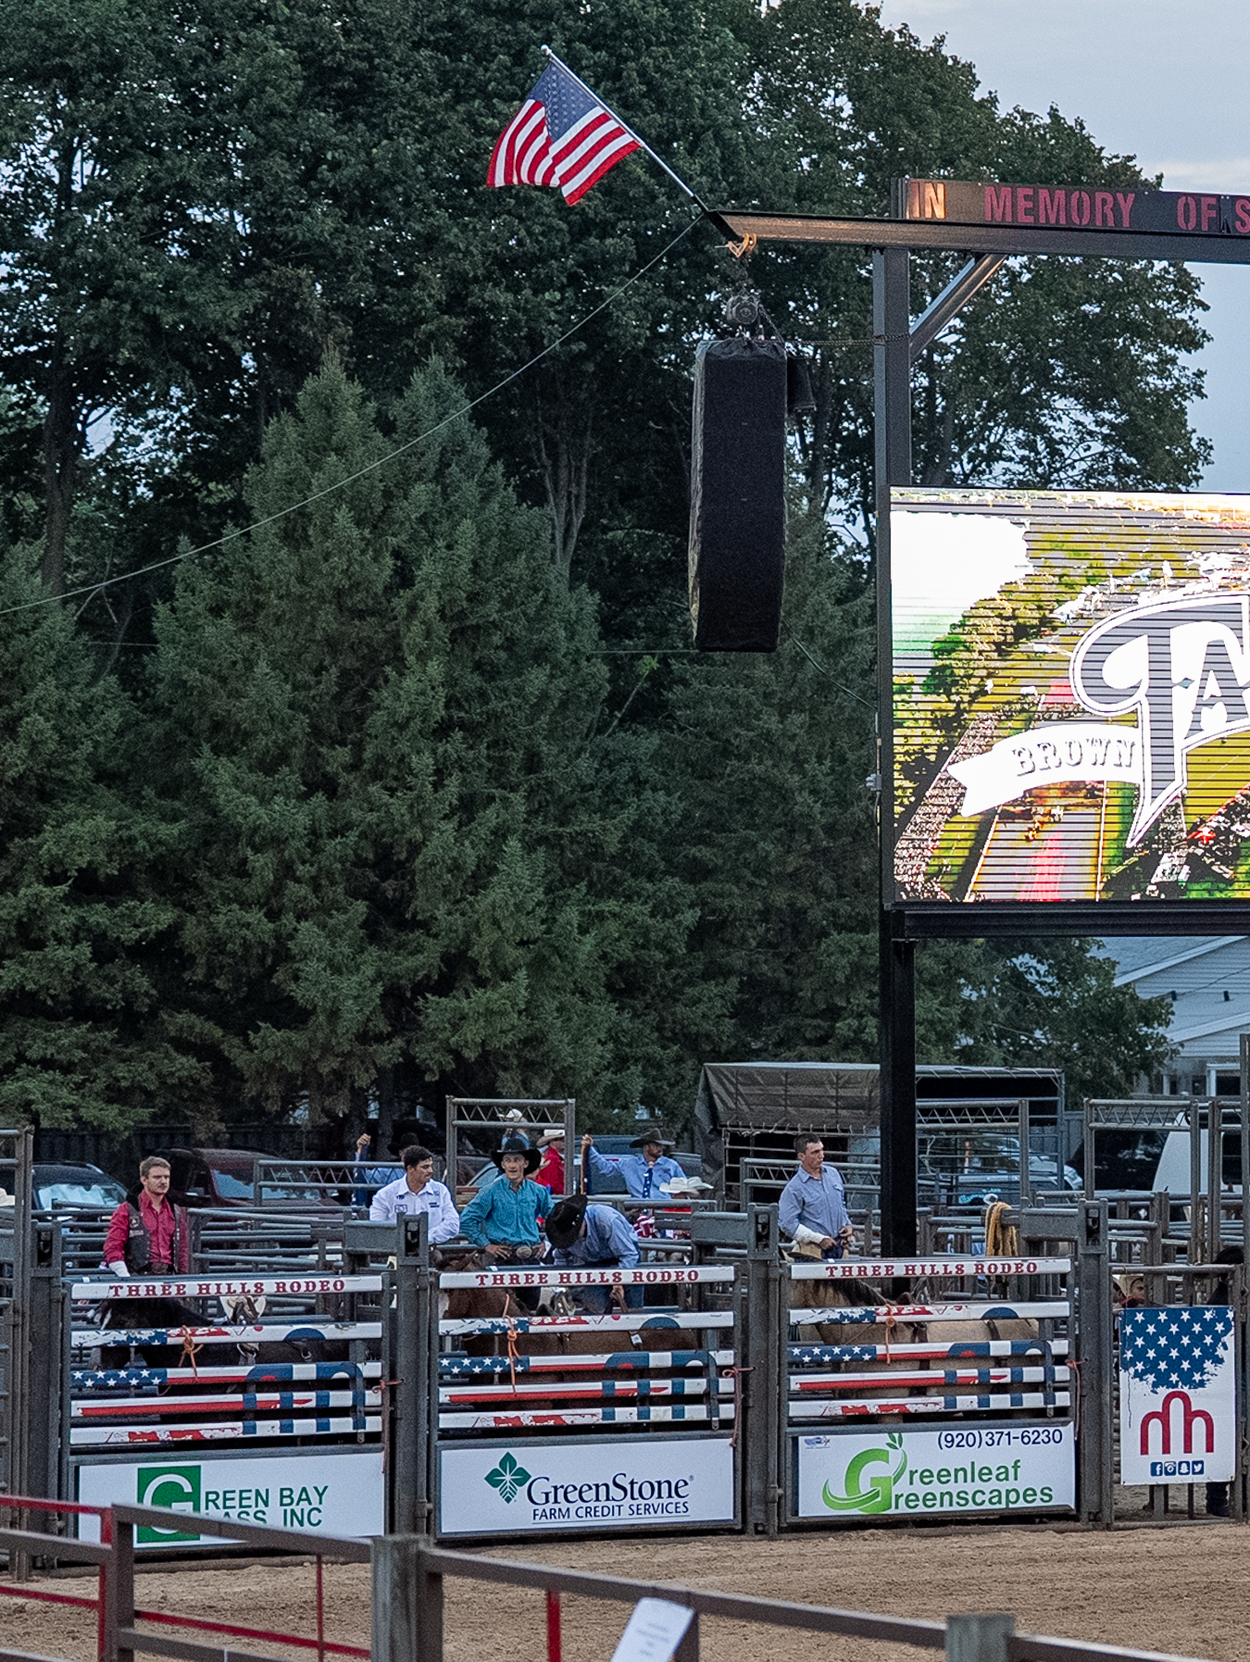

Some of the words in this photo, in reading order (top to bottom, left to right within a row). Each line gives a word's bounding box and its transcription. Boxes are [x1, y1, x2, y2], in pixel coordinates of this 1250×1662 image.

[911, 181, 946, 219] IN
[984, 185, 1137, 228] MEMORY
[1177, 194, 1217, 232] OF
[1011, 738, 1134, 776] BROWN
[476, 1273, 548, 1286] THREE
[558, 1271, 622, 1284] HILLS
[632, 1270, 699, 1283] RODEO
[826, 1265, 894, 1278] THREE
[903, 1263, 965, 1276] HILLS
[974, 1262, 1038, 1275] RODEO
[110, 1284, 187, 1298] THREE
[196, 1282, 265, 1295] HILLS
[274, 1280, 346, 1294] RODEO
[279, 1486, 329, 1507] BAY
[527, 1473, 689, 1506] GreenStone
[283, 1507, 322, 1527] INC
[532, 1507, 570, 1521] FARM
[575, 1504, 624, 1518] CREDIT
[628, 1501, 689, 1516] SERVICES
